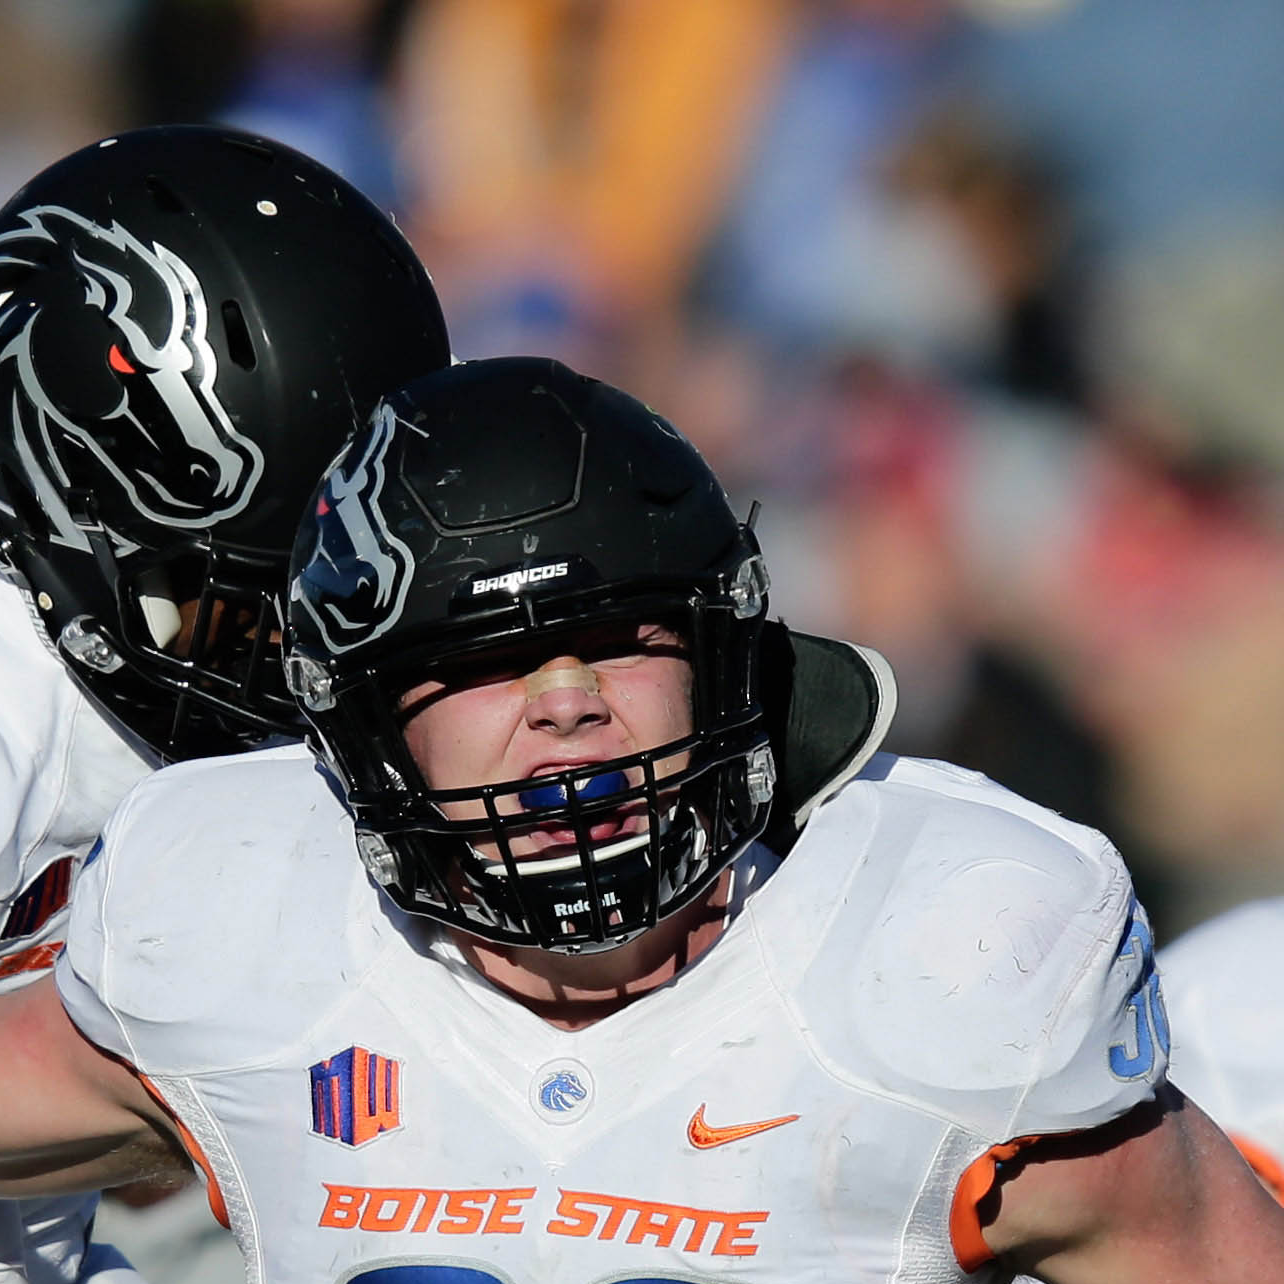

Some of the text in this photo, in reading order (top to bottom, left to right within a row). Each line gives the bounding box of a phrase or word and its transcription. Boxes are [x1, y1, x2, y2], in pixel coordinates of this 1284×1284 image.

[472, 562, 569, 595] BRONCOS
[318, 1183, 770, 1257] BOISE STATE
